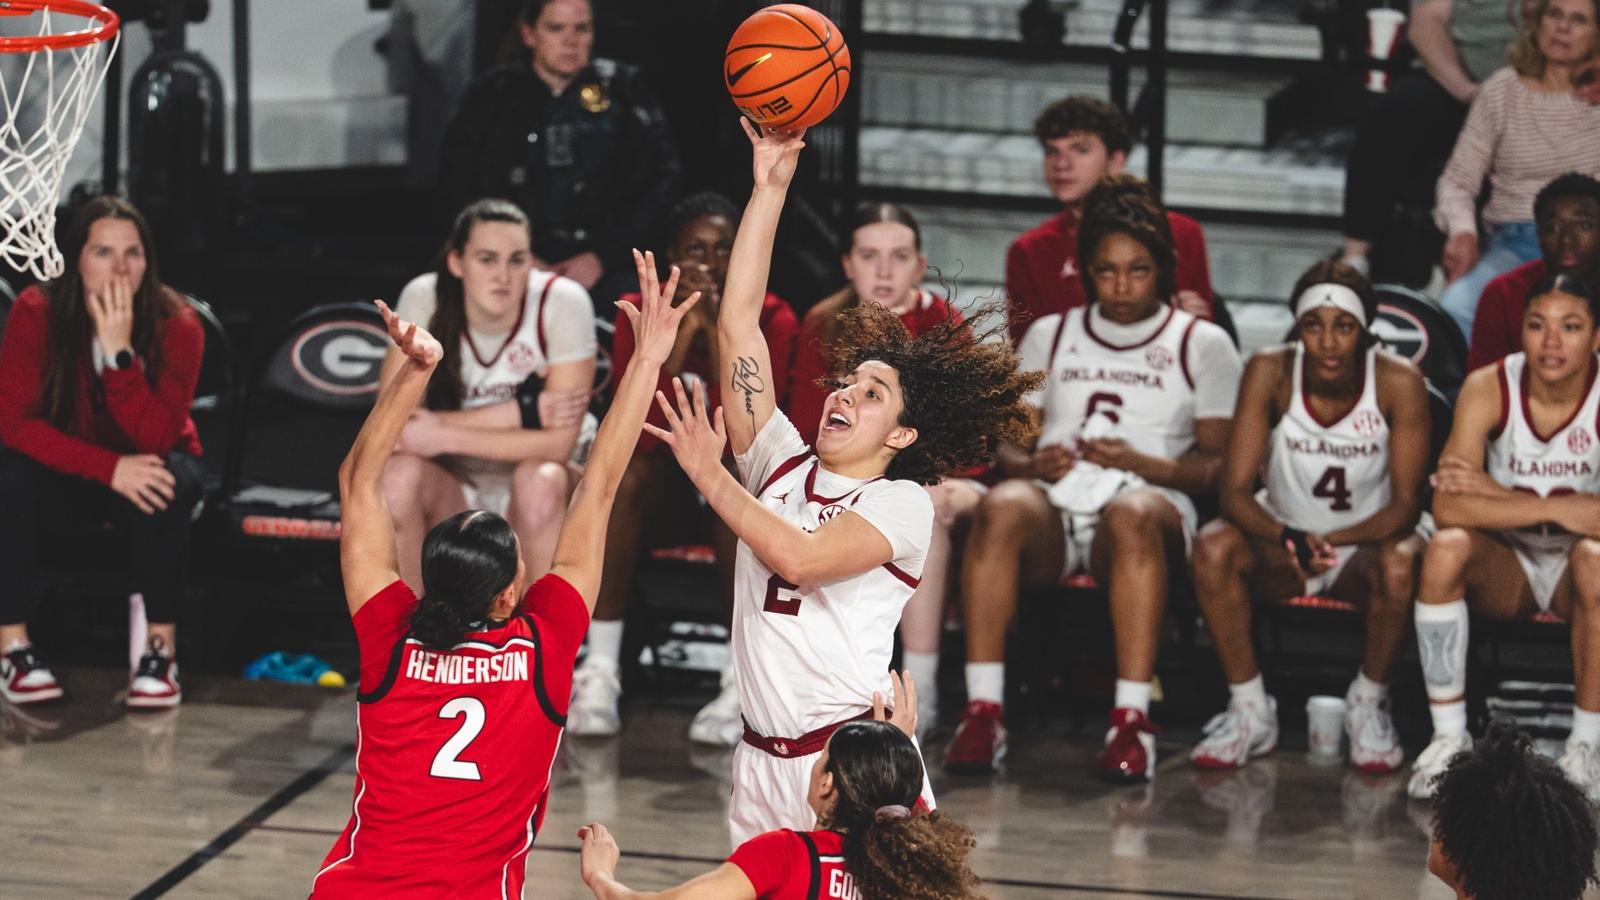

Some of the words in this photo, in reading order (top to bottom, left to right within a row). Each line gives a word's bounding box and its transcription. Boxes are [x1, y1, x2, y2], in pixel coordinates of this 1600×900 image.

[1312, 466, 1352, 512] 4
[763, 573, 802, 616] 2
[405, 649, 529, 685] HENDERSON
[429, 695, 483, 782] 2
